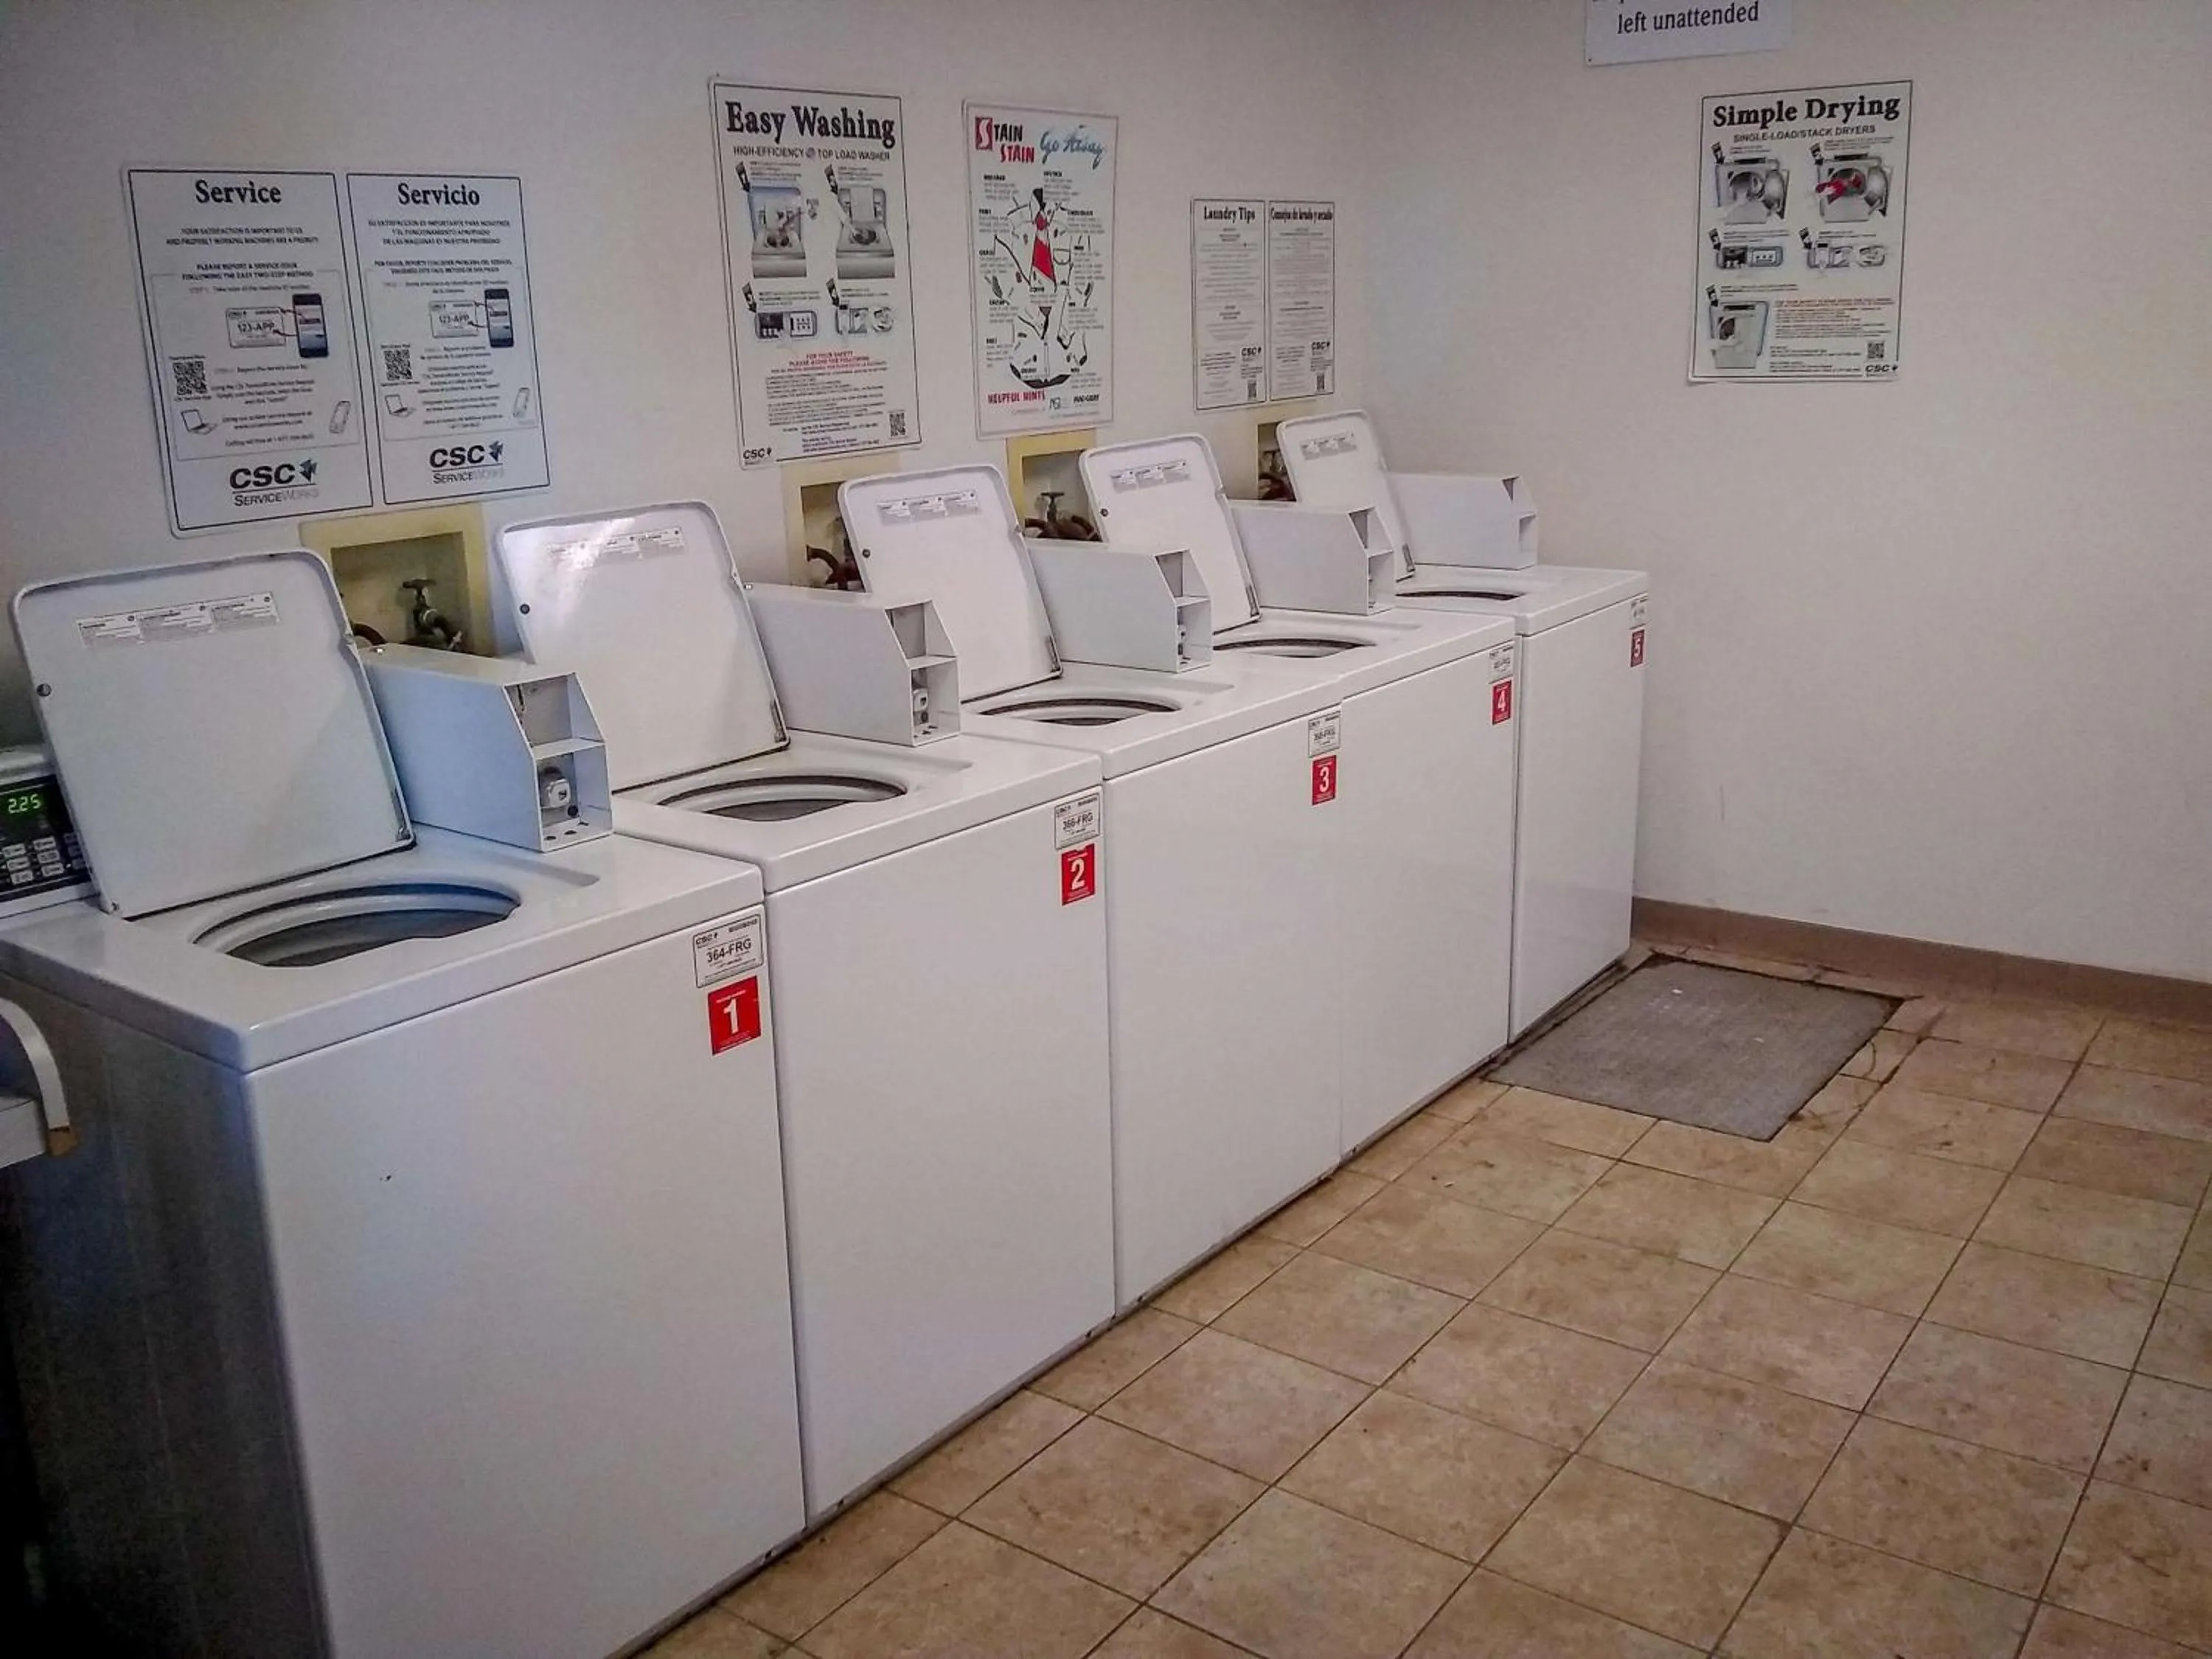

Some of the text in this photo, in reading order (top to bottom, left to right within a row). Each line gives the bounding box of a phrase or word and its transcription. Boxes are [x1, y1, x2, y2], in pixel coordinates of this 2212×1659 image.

[1618, 1, 1759, 35] left unattended
[1713, 95, 1901, 130] Simple Drying
[726, 101, 897, 149] Easy Washing
[1835, 125, 1877, 136] DRYERS
[733, 146, 891, 161] HIGH-EFFICIENCY TOP LOAD WASHER
[1001, 145, 1035, 163] STAIN
[1040, 125, 1105, 170] Go Away
[195, 179, 282, 204] Service
[397, 182, 481, 206] Servicio
[1204, 206, 1256, 224] Laundry Tips
[1242, 347, 1257, 356] CSC
[988, 392, 1020, 404] HELPFUL
[429, 445, 485, 468] CSC
[742, 448, 765, 460] CSC
[229, 463, 296, 489] CSC
[1633, 638, 1641, 658] 5
[1498, 689, 1506, 712] 4
[1319, 766, 1330, 793] 3
[1071, 858, 1085, 891] 2
[706, 939, 751, 964] 364-FRG
[723, 998, 739, 1034] 1
